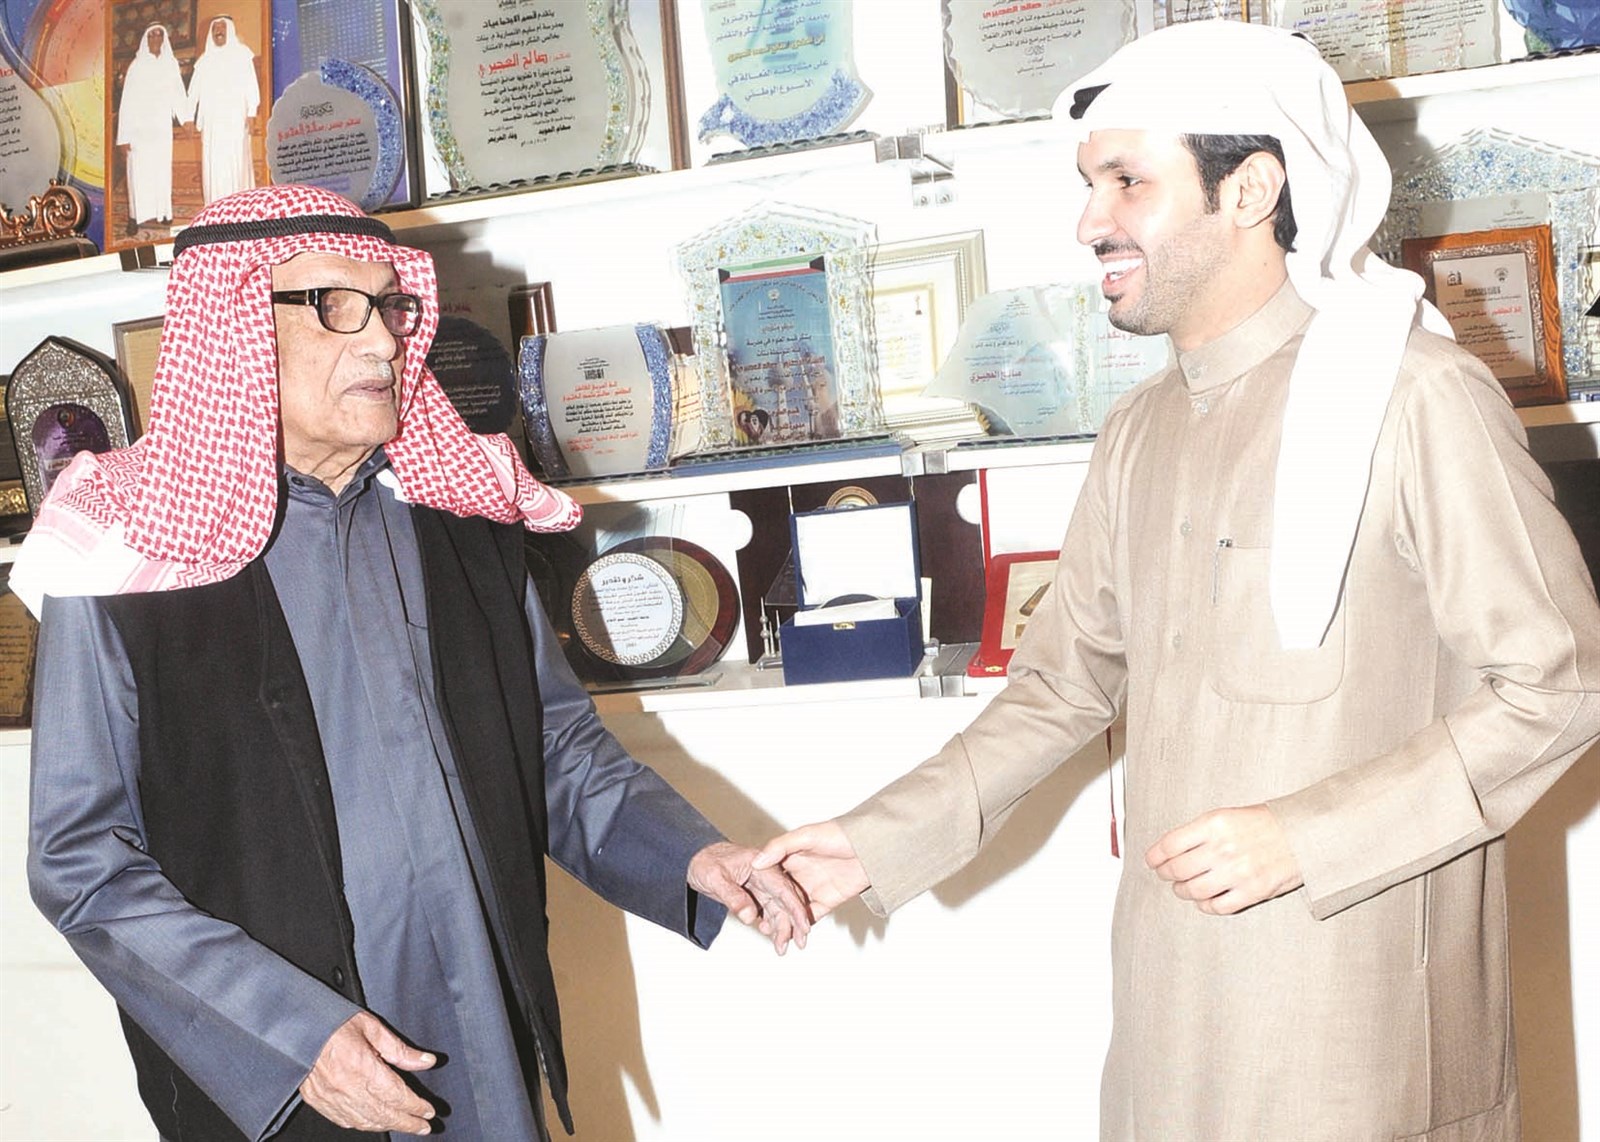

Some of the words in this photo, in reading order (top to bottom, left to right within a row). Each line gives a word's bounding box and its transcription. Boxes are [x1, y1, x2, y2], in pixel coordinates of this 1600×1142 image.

[478, 52, 520, 78] العجيري
[522, 49, 549, 69] صالح
[969, 371, 999, 383] العجيري
